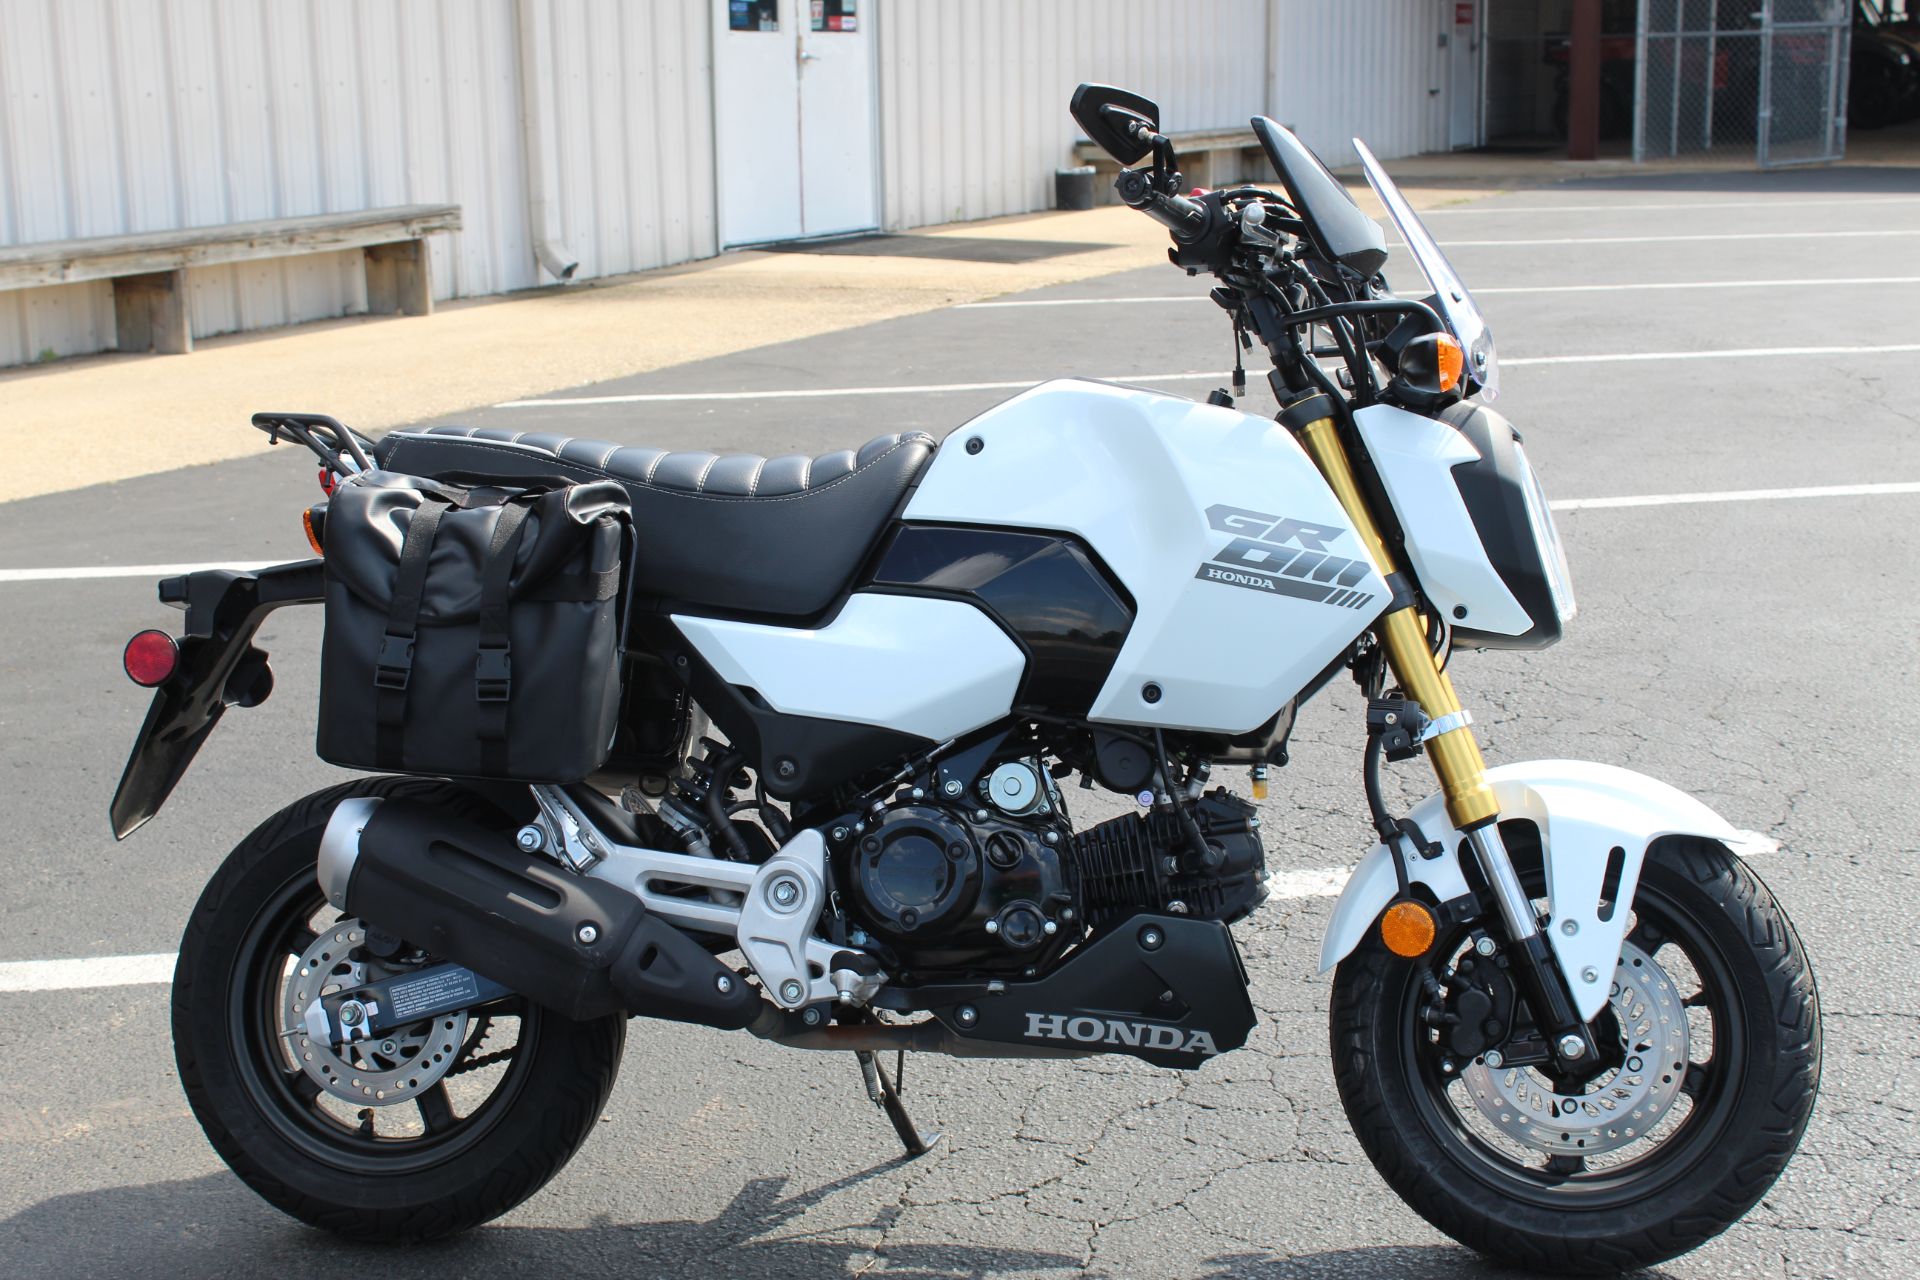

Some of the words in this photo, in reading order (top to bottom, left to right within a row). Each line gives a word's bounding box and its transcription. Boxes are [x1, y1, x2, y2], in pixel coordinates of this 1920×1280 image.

[1205, 504, 1346, 552] GR
[1207, 568, 1276, 590] HONDA
[1024, 1013, 1222, 1055] HONDA
